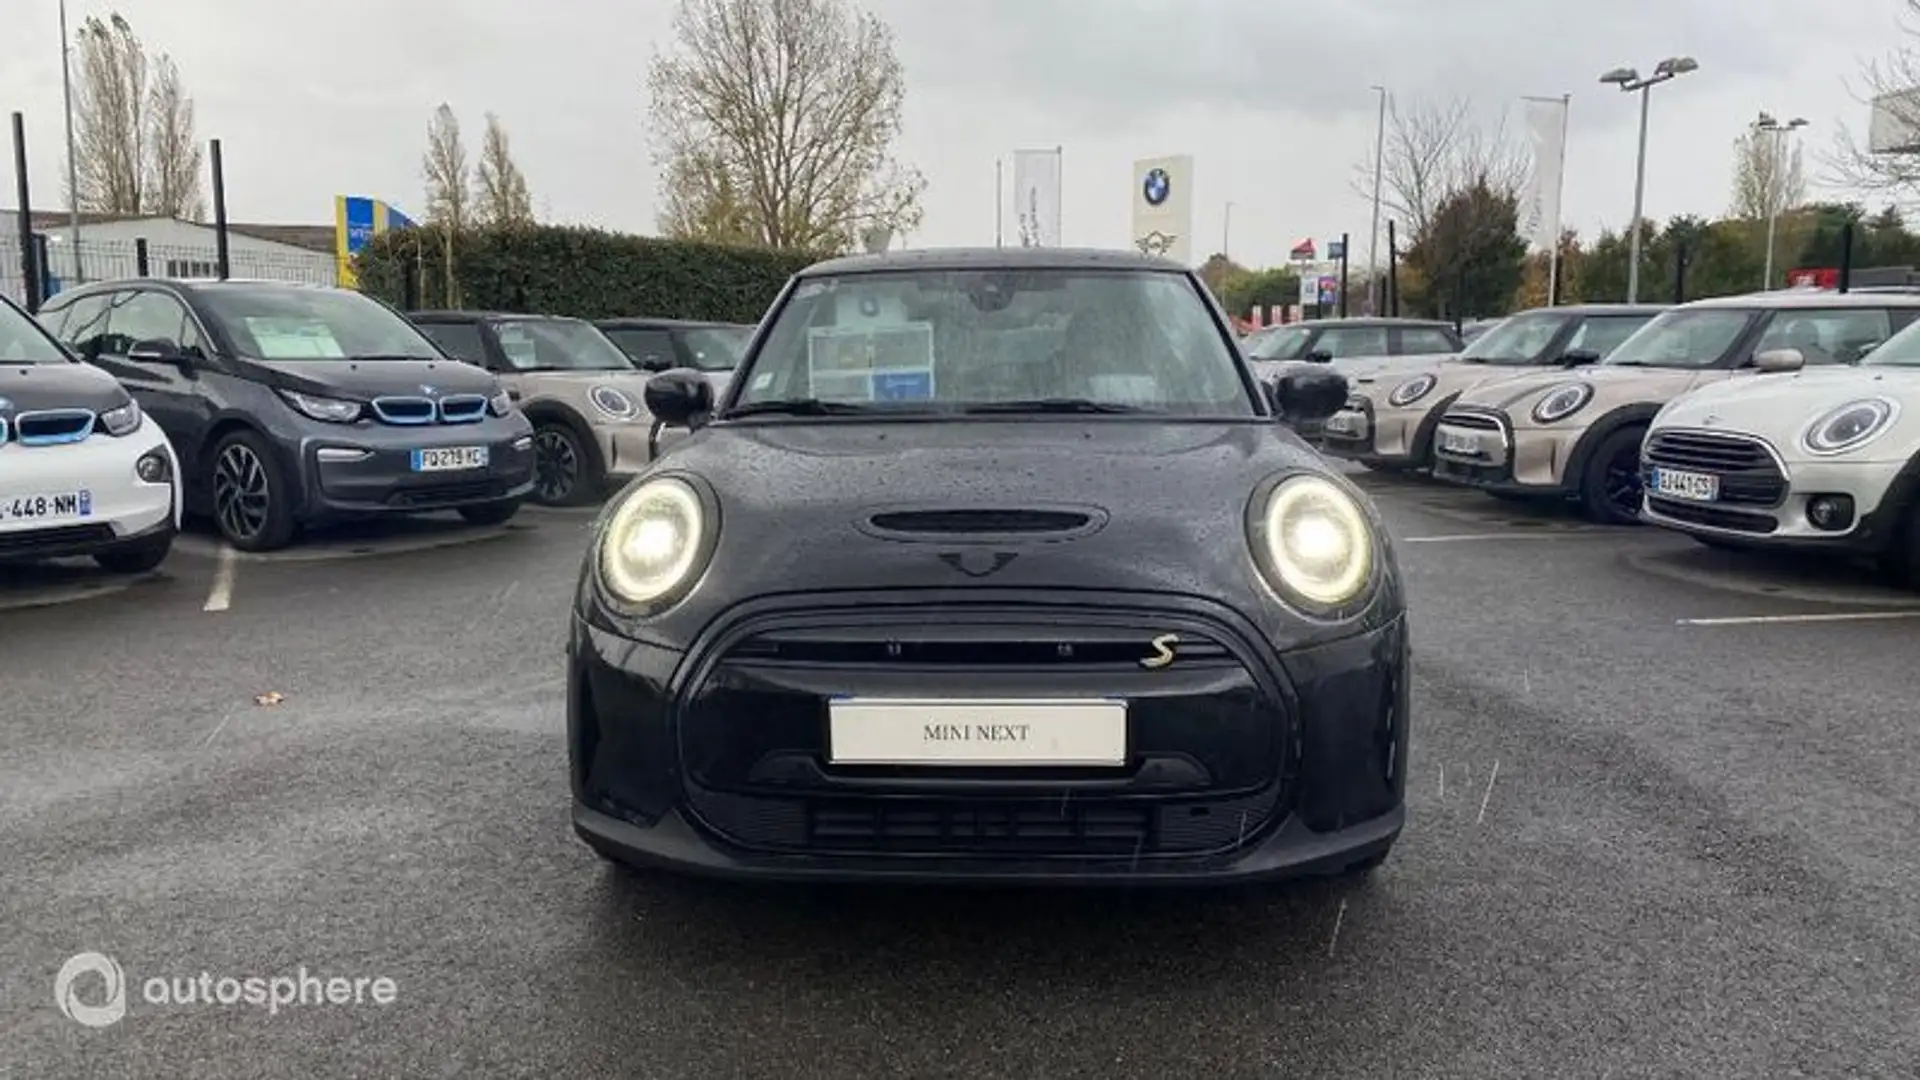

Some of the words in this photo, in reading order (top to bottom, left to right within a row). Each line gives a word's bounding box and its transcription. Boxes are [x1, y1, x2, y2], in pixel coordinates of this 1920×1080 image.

[1140, 633, 1179, 667] S
[923, 724, 970, 741] MINI
[976, 724, 1030, 741] NEXT
